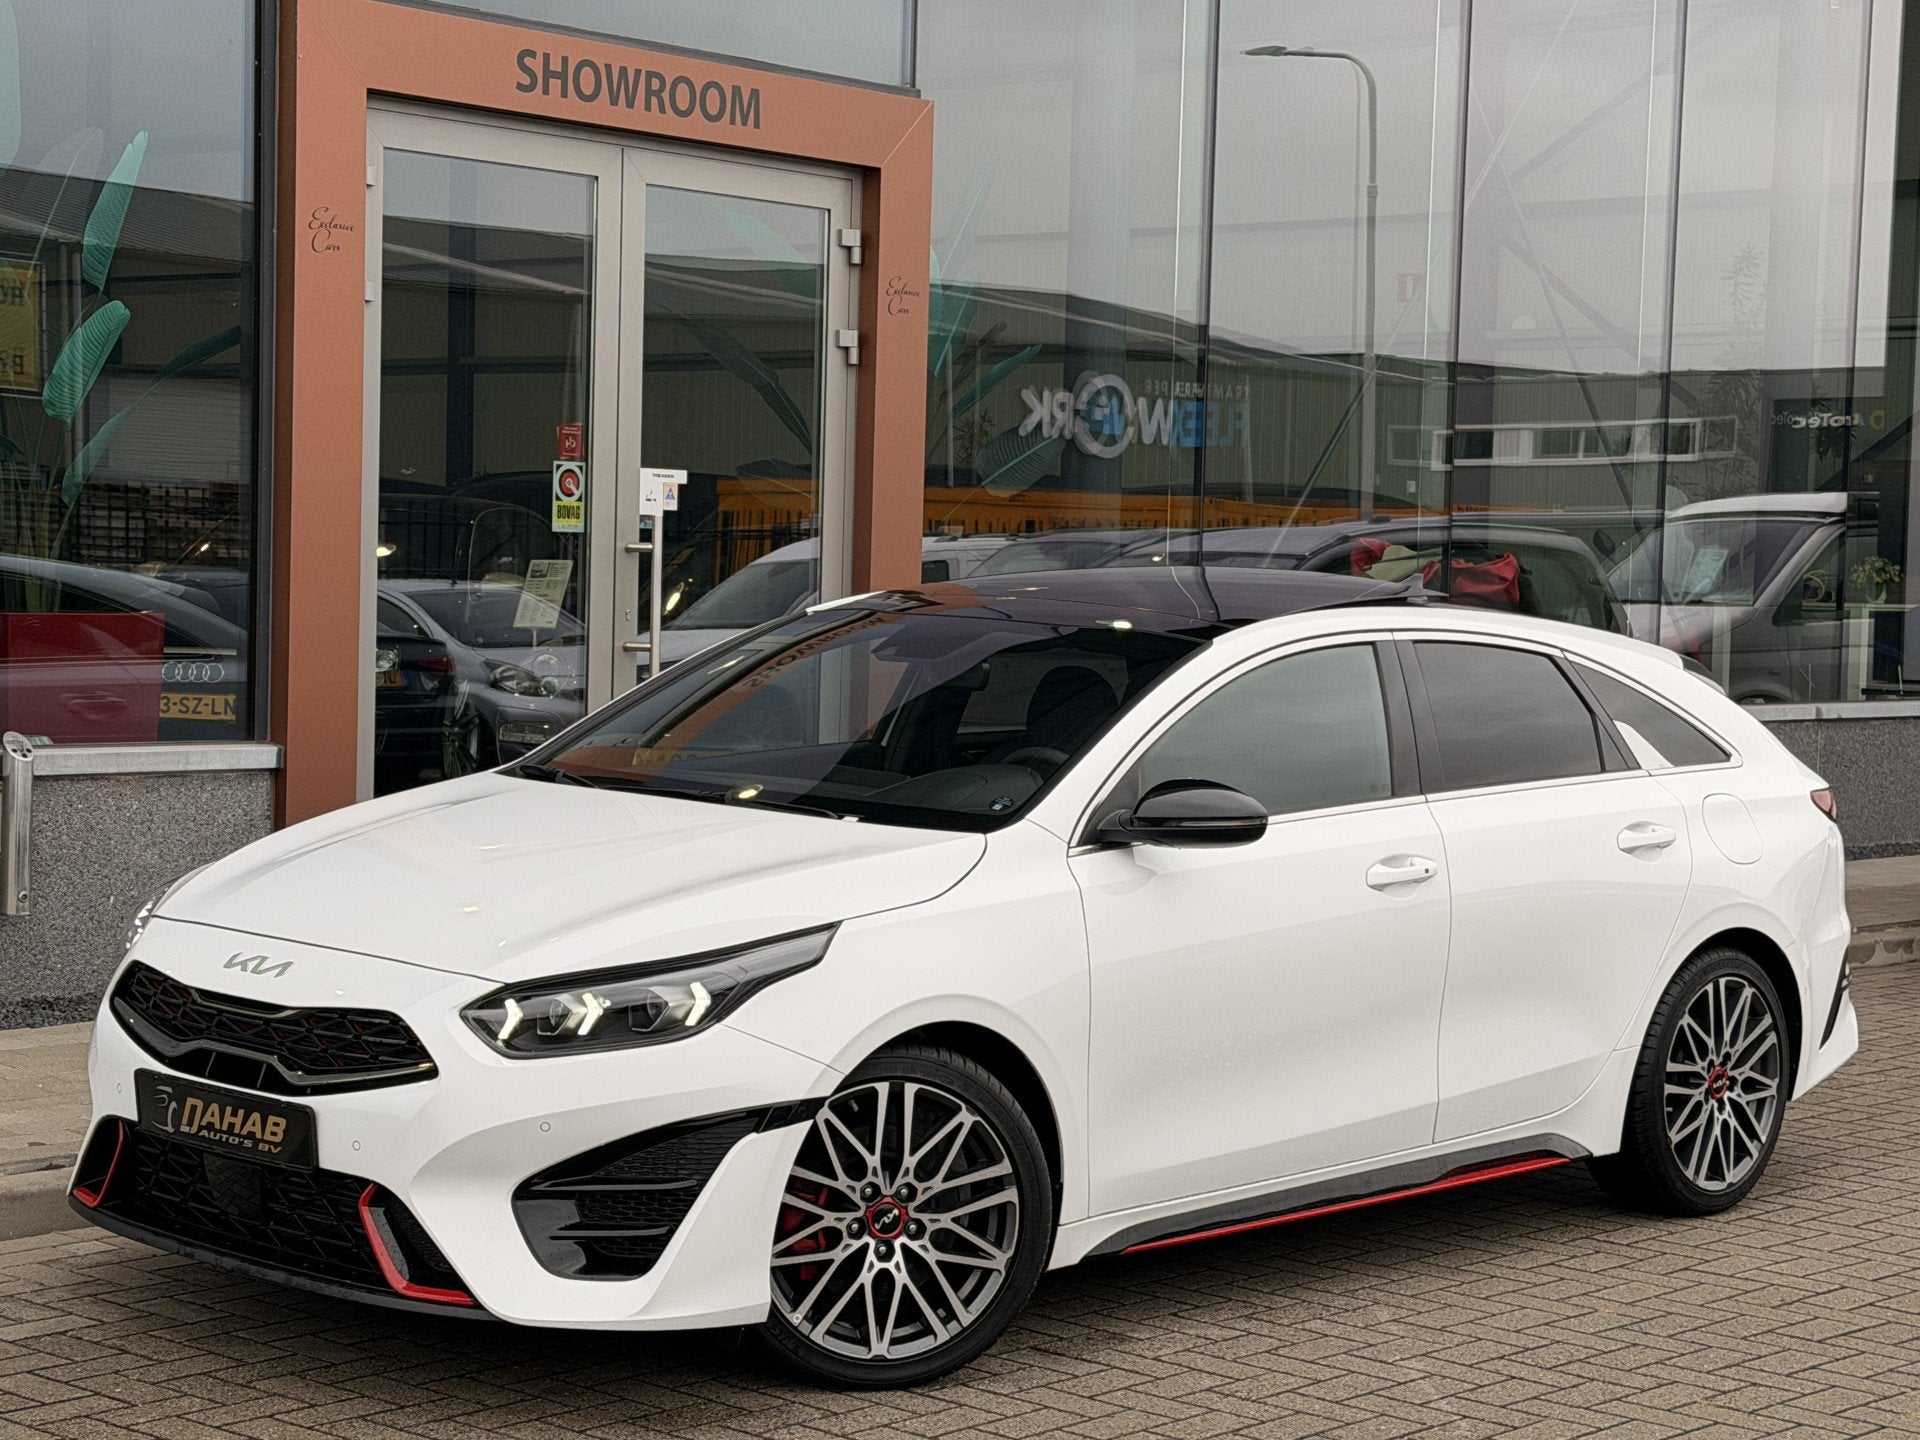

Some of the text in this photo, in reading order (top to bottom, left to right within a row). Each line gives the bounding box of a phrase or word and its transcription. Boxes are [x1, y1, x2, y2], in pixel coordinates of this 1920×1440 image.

[515, 48, 761, 130] SHOWROOM
[308, 206, 355, 232] Exclusive
[311, 228, 341, 254] Cars
[885, 275, 922, 298] Exclusive
[556, 504, 581, 520] BOVAG
[179, 1096, 288, 1143] DAHAB
[197, 1129, 283, 1155] AUTO'S BV
